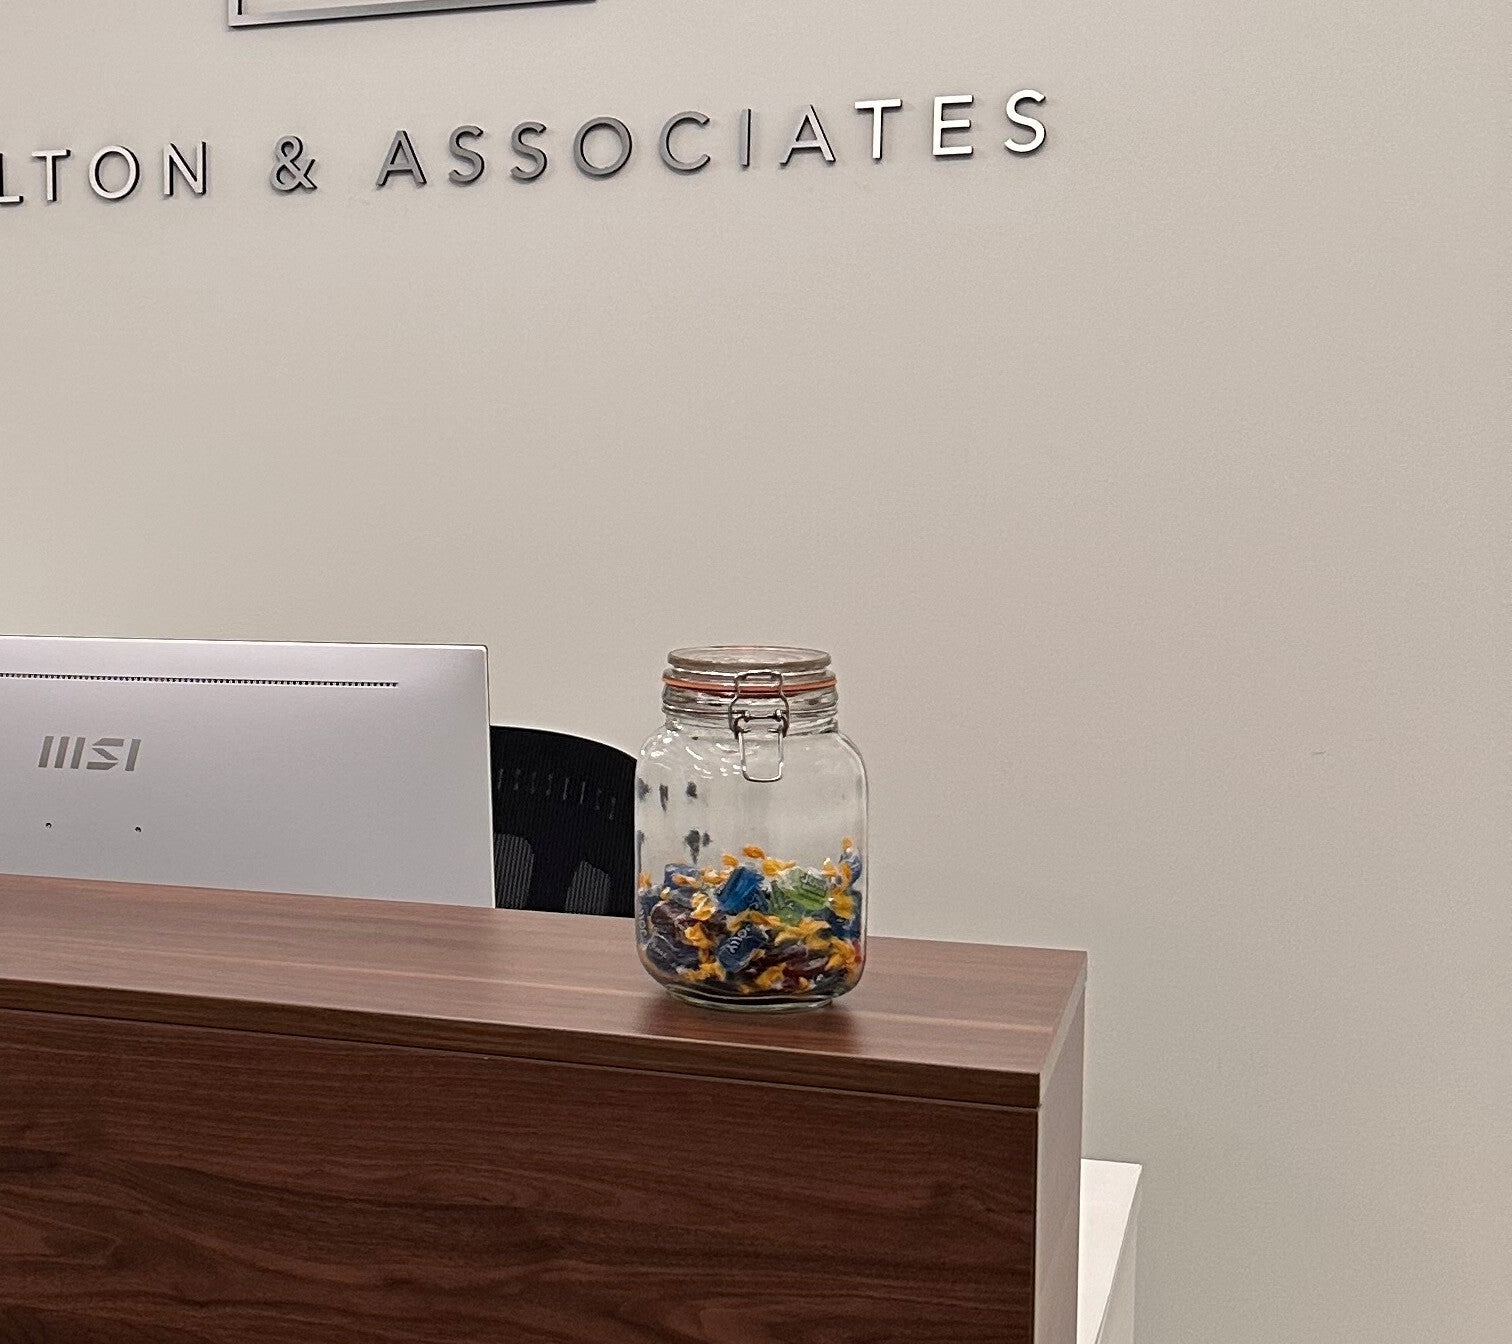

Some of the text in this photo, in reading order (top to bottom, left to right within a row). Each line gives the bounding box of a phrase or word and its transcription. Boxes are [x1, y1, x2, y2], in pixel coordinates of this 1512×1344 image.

[270, 134, 317, 193] &
[376, 88, 1048, 187] ASSOCIATES
[38, 735, 142, 771] MSI
